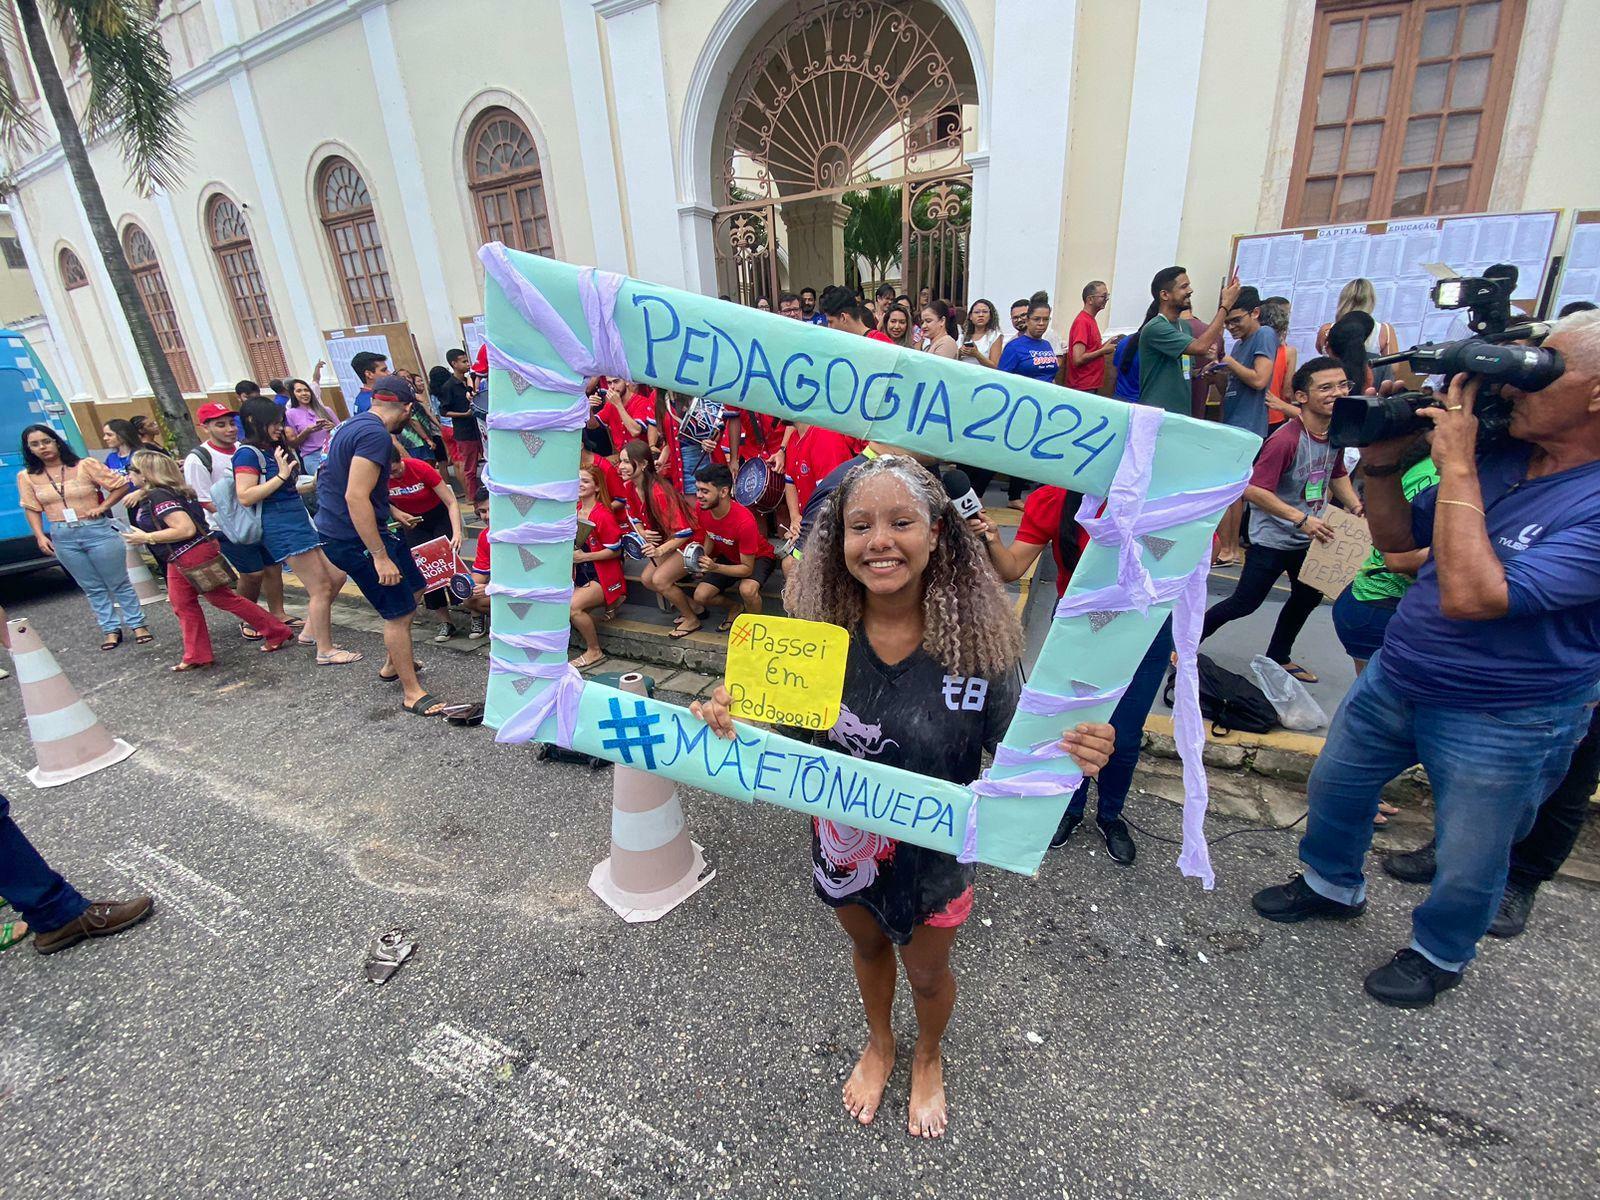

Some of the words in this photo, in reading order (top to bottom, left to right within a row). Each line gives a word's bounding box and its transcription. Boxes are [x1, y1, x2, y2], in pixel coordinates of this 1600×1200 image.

[1319, 226, 1366, 237] CAPITAL
[1388, 221, 1437, 233] EDUCAÇÃO
[631, 295, 954, 443] PEDAGOGIA
[962, 383, 1117, 476] 2024
[1327, 511, 1372, 543] CALOU
[1321, 540, 1364, 562] UEP
[419, 558, 446, 573] LHOR
[422, 561, 455, 580] NORTE
[1303, 558, 1350, 584] PEDA
[731, 622, 827, 660] #Passei
[728, 683, 828, 729] Pedagogia!
